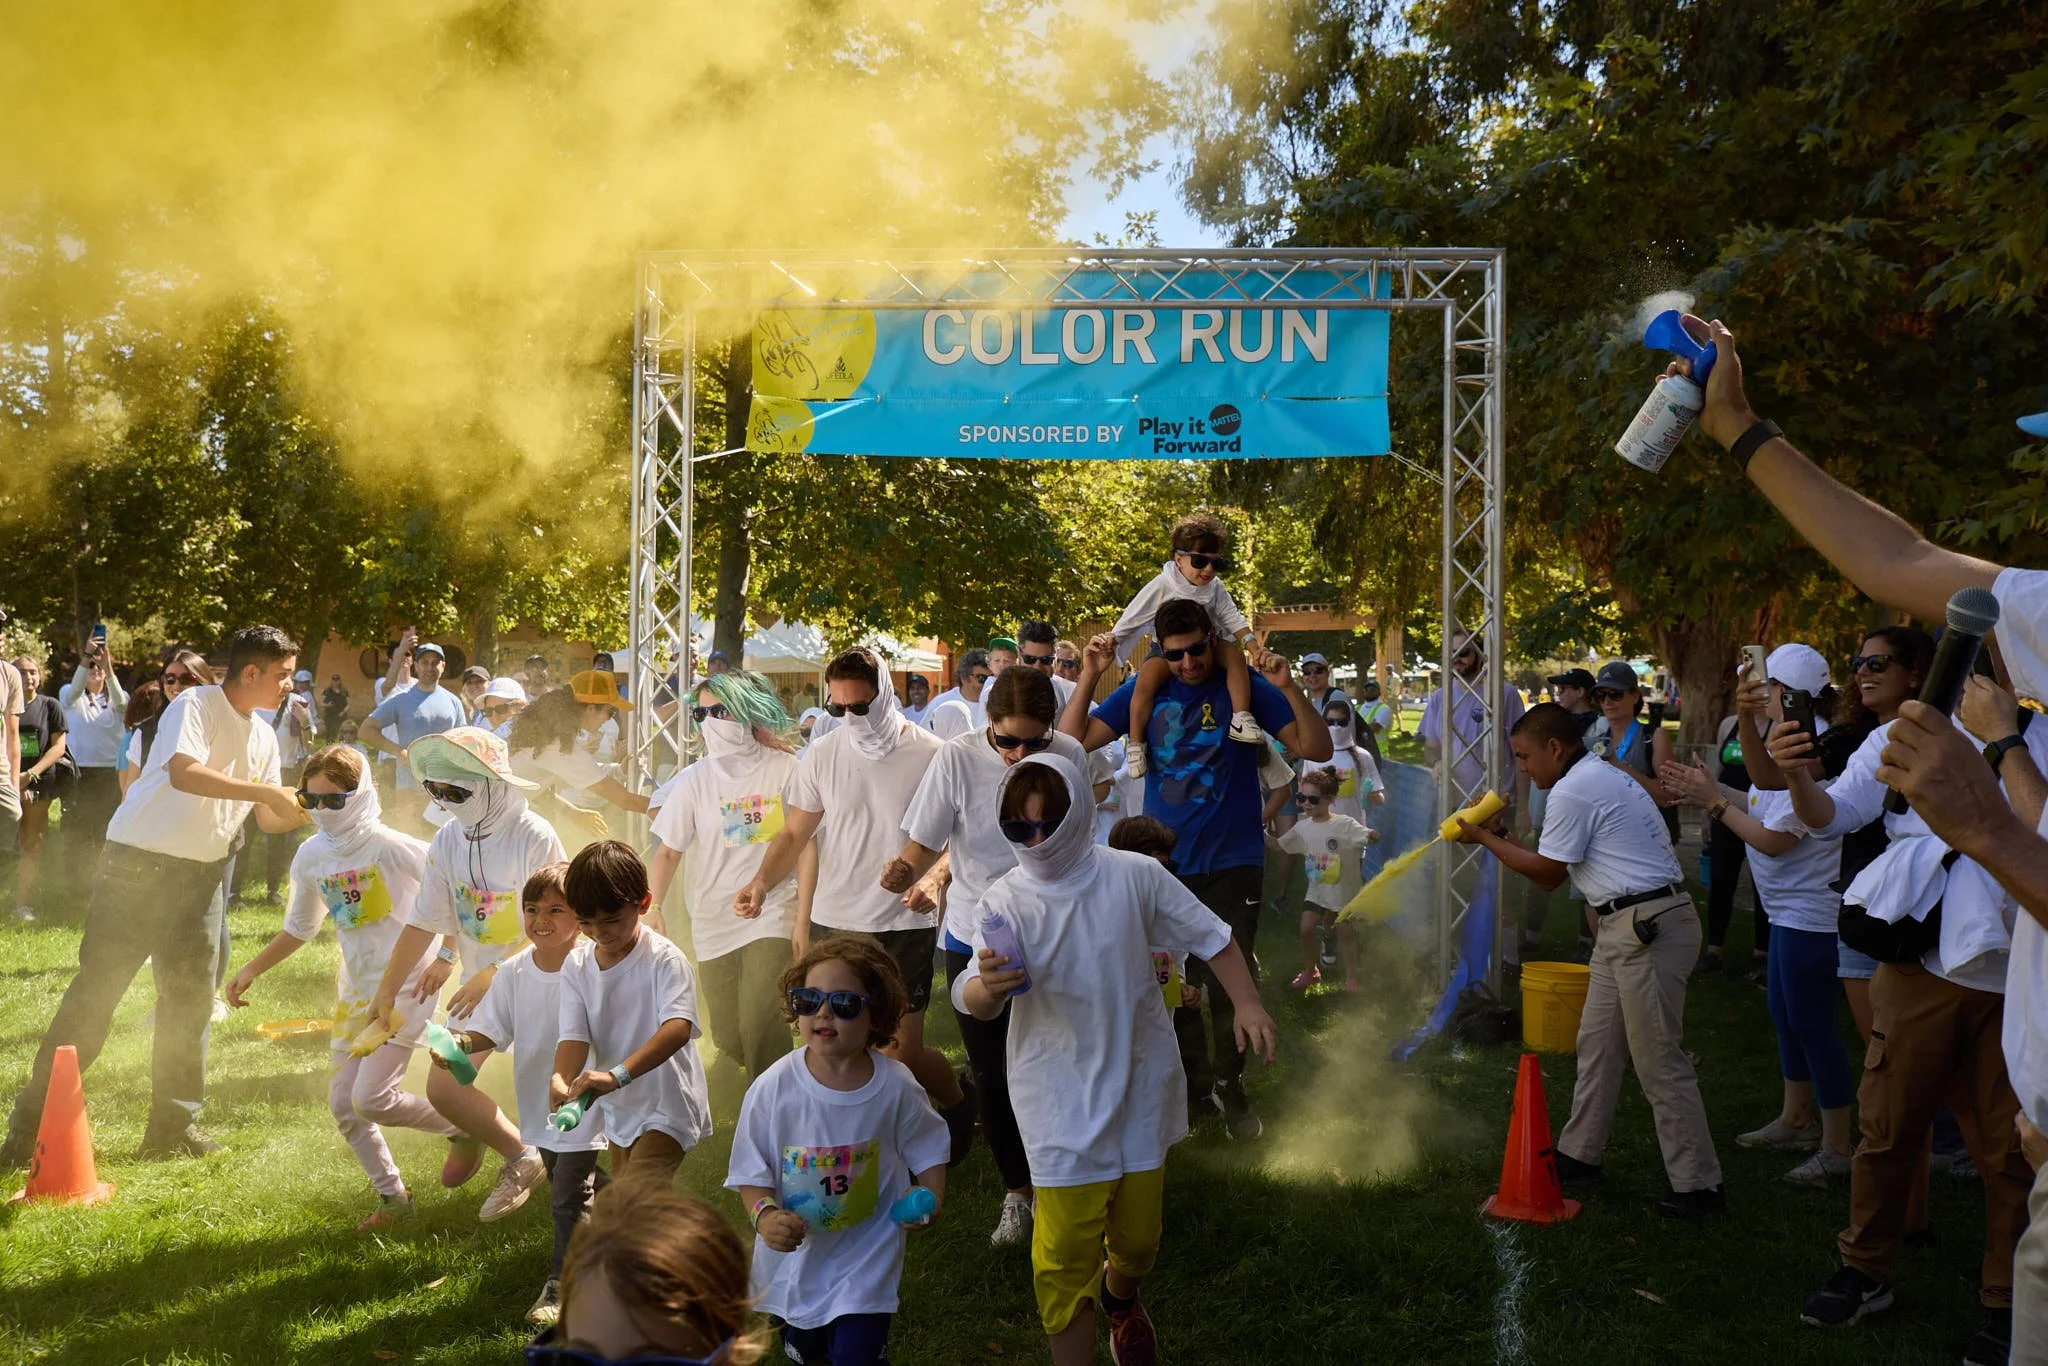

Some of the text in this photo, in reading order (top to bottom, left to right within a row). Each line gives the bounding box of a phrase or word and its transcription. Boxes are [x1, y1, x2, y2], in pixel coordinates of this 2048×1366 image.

[922, 308, 1158, 366] COLOR
[1179, 308, 1328, 363] RUN
[959, 425, 1124, 443] SPONSORED BY
[1139, 416, 1205, 438] Play it
[1154, 436, 1241, 453] Forward
[743, 811, 762, 826] 38
[342, 888, 362, 905] 39
[475, 907, 487, 922] 6
[820, 1174, 848, 1196] 13
